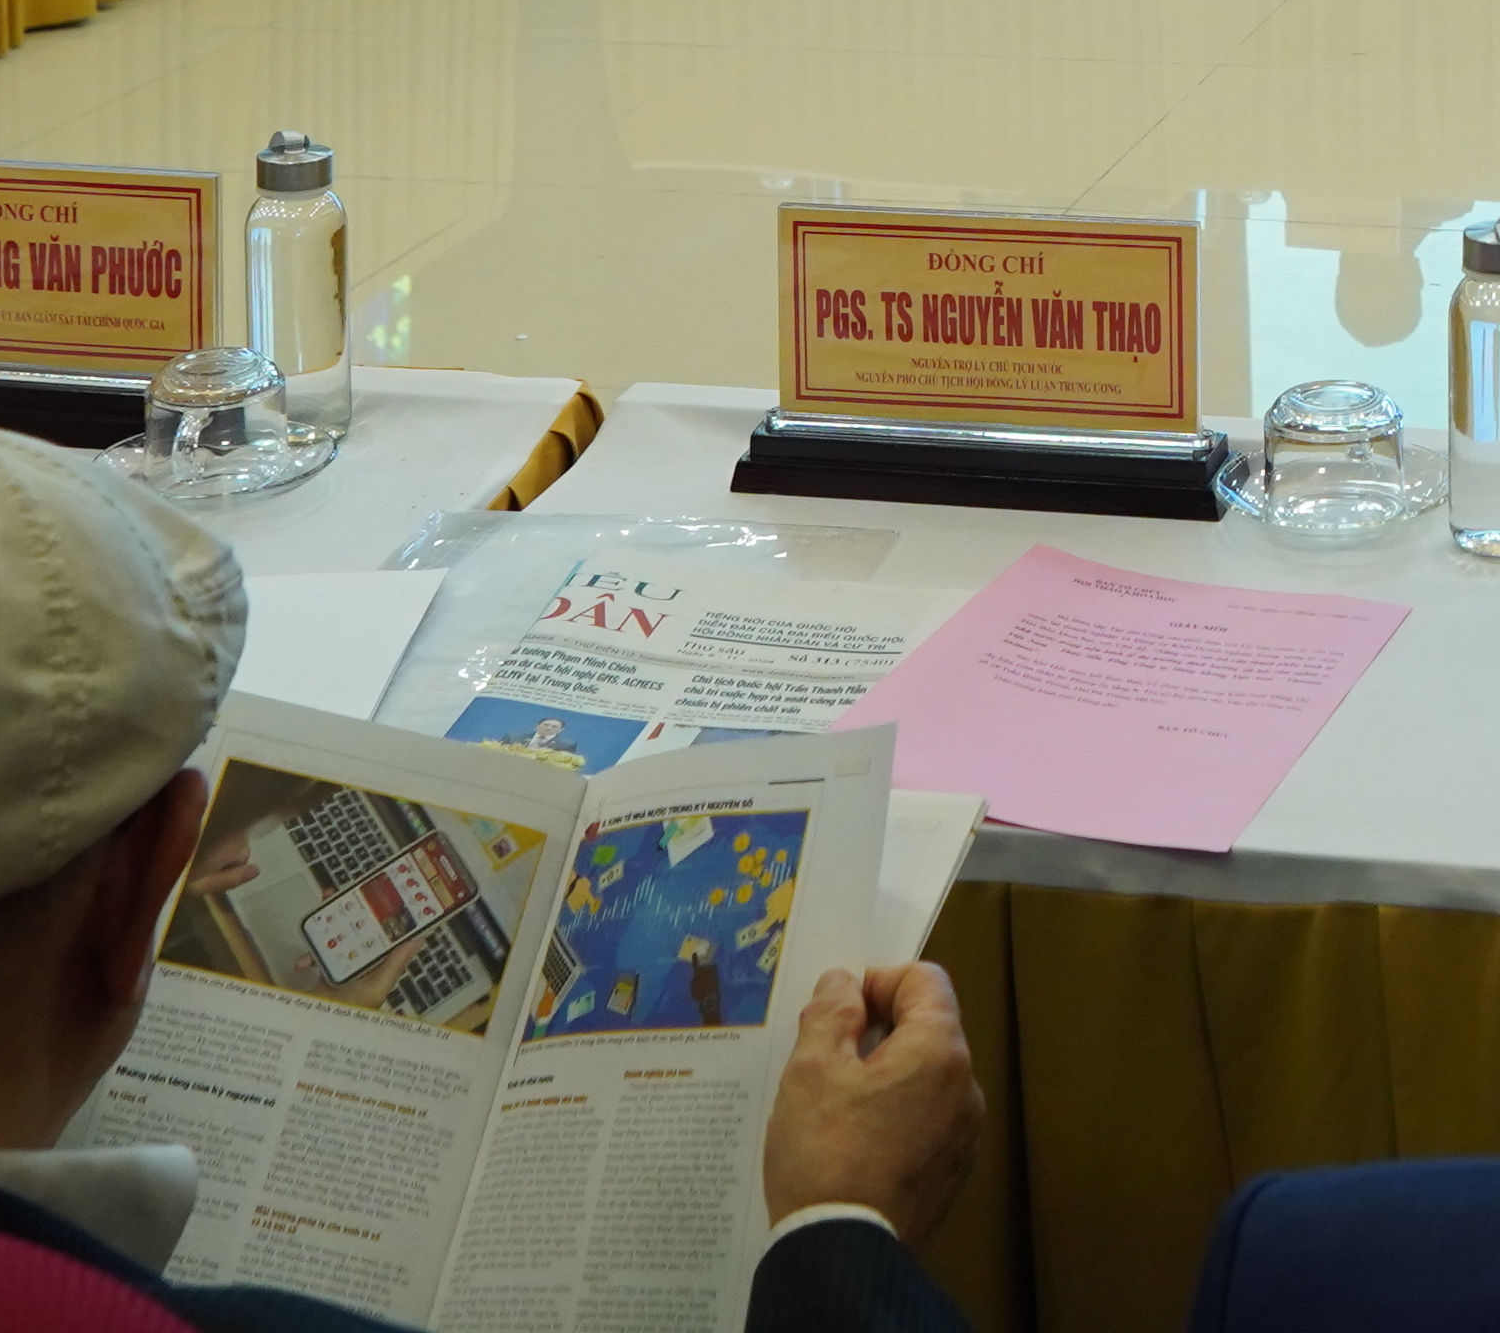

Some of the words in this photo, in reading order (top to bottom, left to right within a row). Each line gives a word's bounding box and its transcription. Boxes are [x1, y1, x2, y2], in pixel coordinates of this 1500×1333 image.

[40, 201, 79, 224] CHÍ
[28, 234, 82, 293] VĂN
[91, 239, 183, 299] PHƯỚC
[927, 248, 996, 273] ĐỒNG
[1002, 251, 1045, 275] CHÍ
[816, 288, 874, 341] PGS.
[881, 291, 914, 343] TS
[922, 279, 1023, 347] NGUYỄN
[1031, 289, 1084, 350] VĂN
[1092, 300, 1162, 364] THẠO
